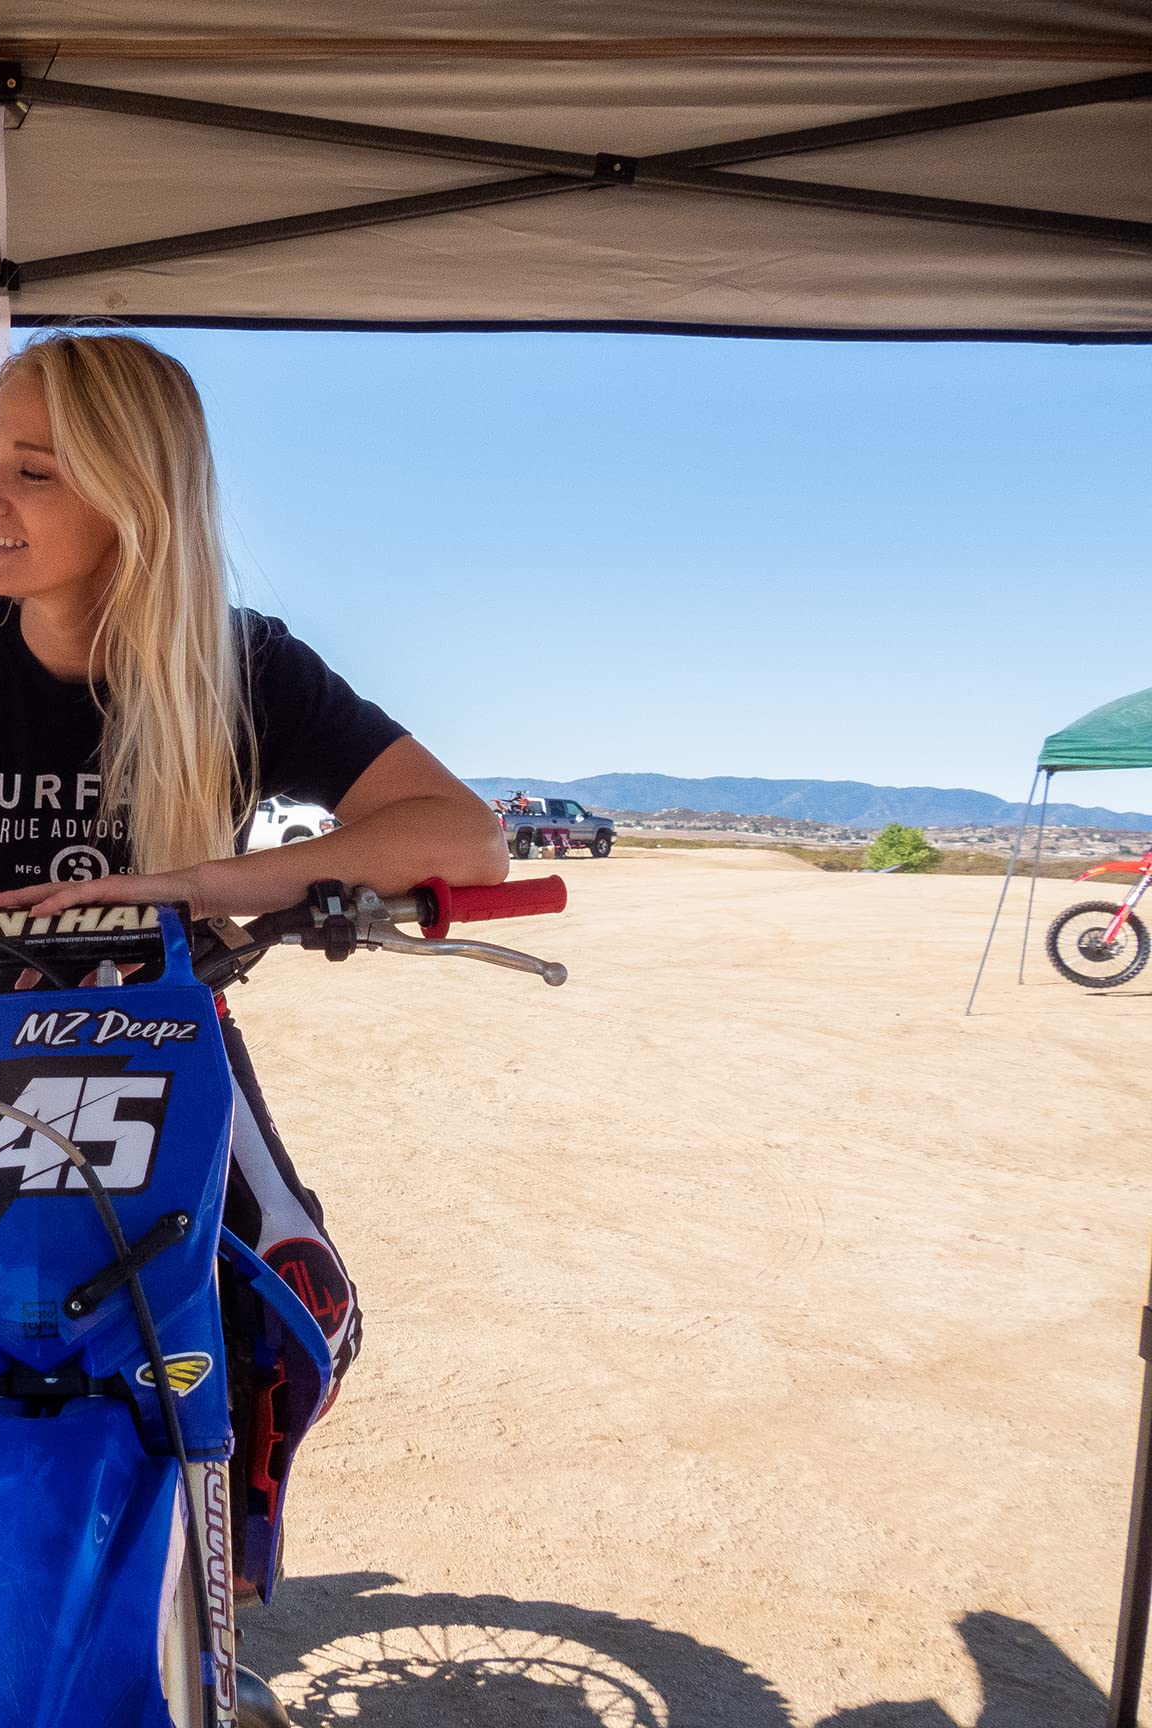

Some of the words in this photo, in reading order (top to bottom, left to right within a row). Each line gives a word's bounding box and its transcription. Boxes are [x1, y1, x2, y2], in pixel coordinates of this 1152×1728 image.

[15, 864, 41, 875] MFG
[15, 1011, 90, 1045] MZ
[94, 1010, 198, 1046] Deepz
